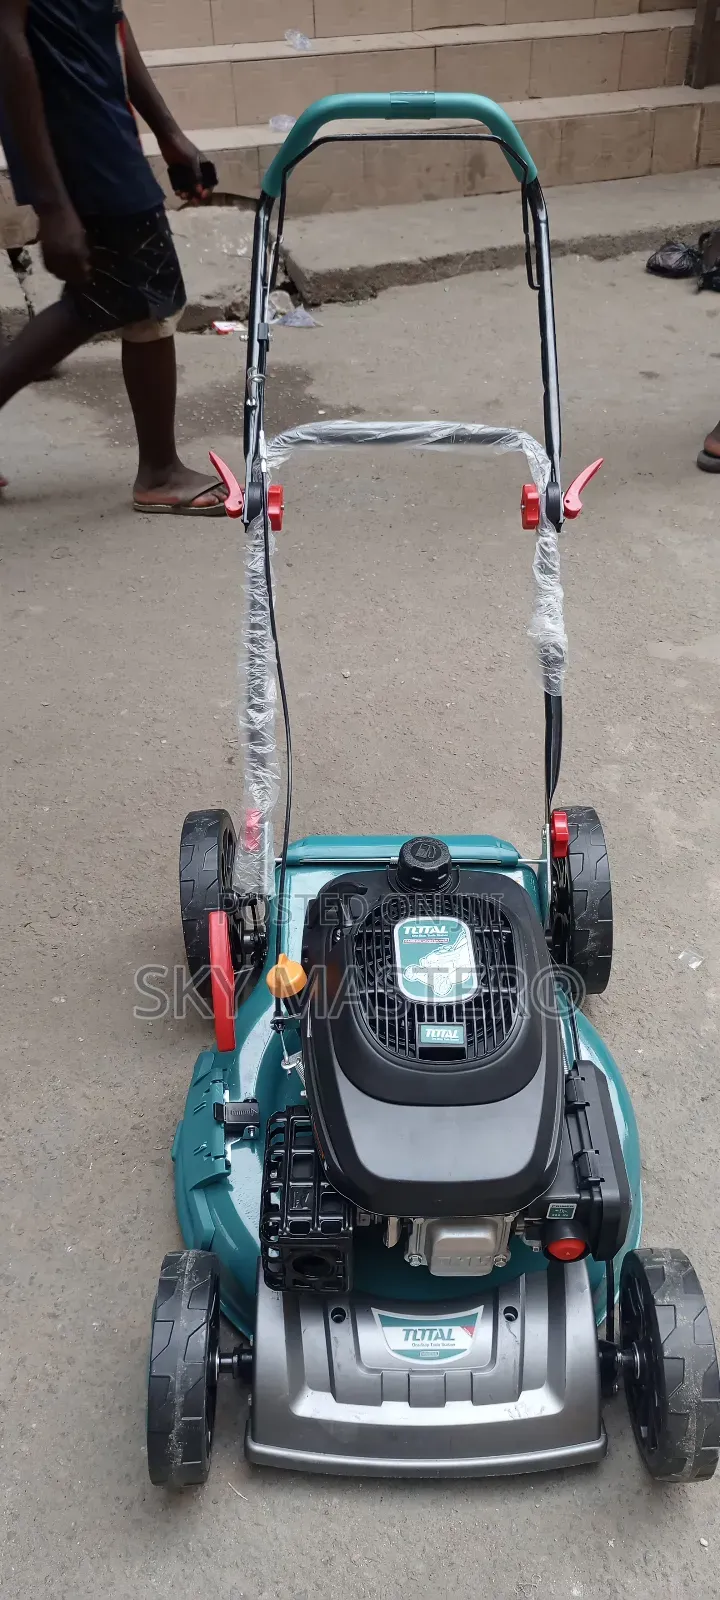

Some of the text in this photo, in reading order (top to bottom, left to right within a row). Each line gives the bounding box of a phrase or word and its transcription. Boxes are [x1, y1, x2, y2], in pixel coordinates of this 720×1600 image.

[403, 925, 448, 934] TOTAL
[425, 1029, 459, 1037] TOTAL
[402, 1329, 455, 1341] TOTAL
